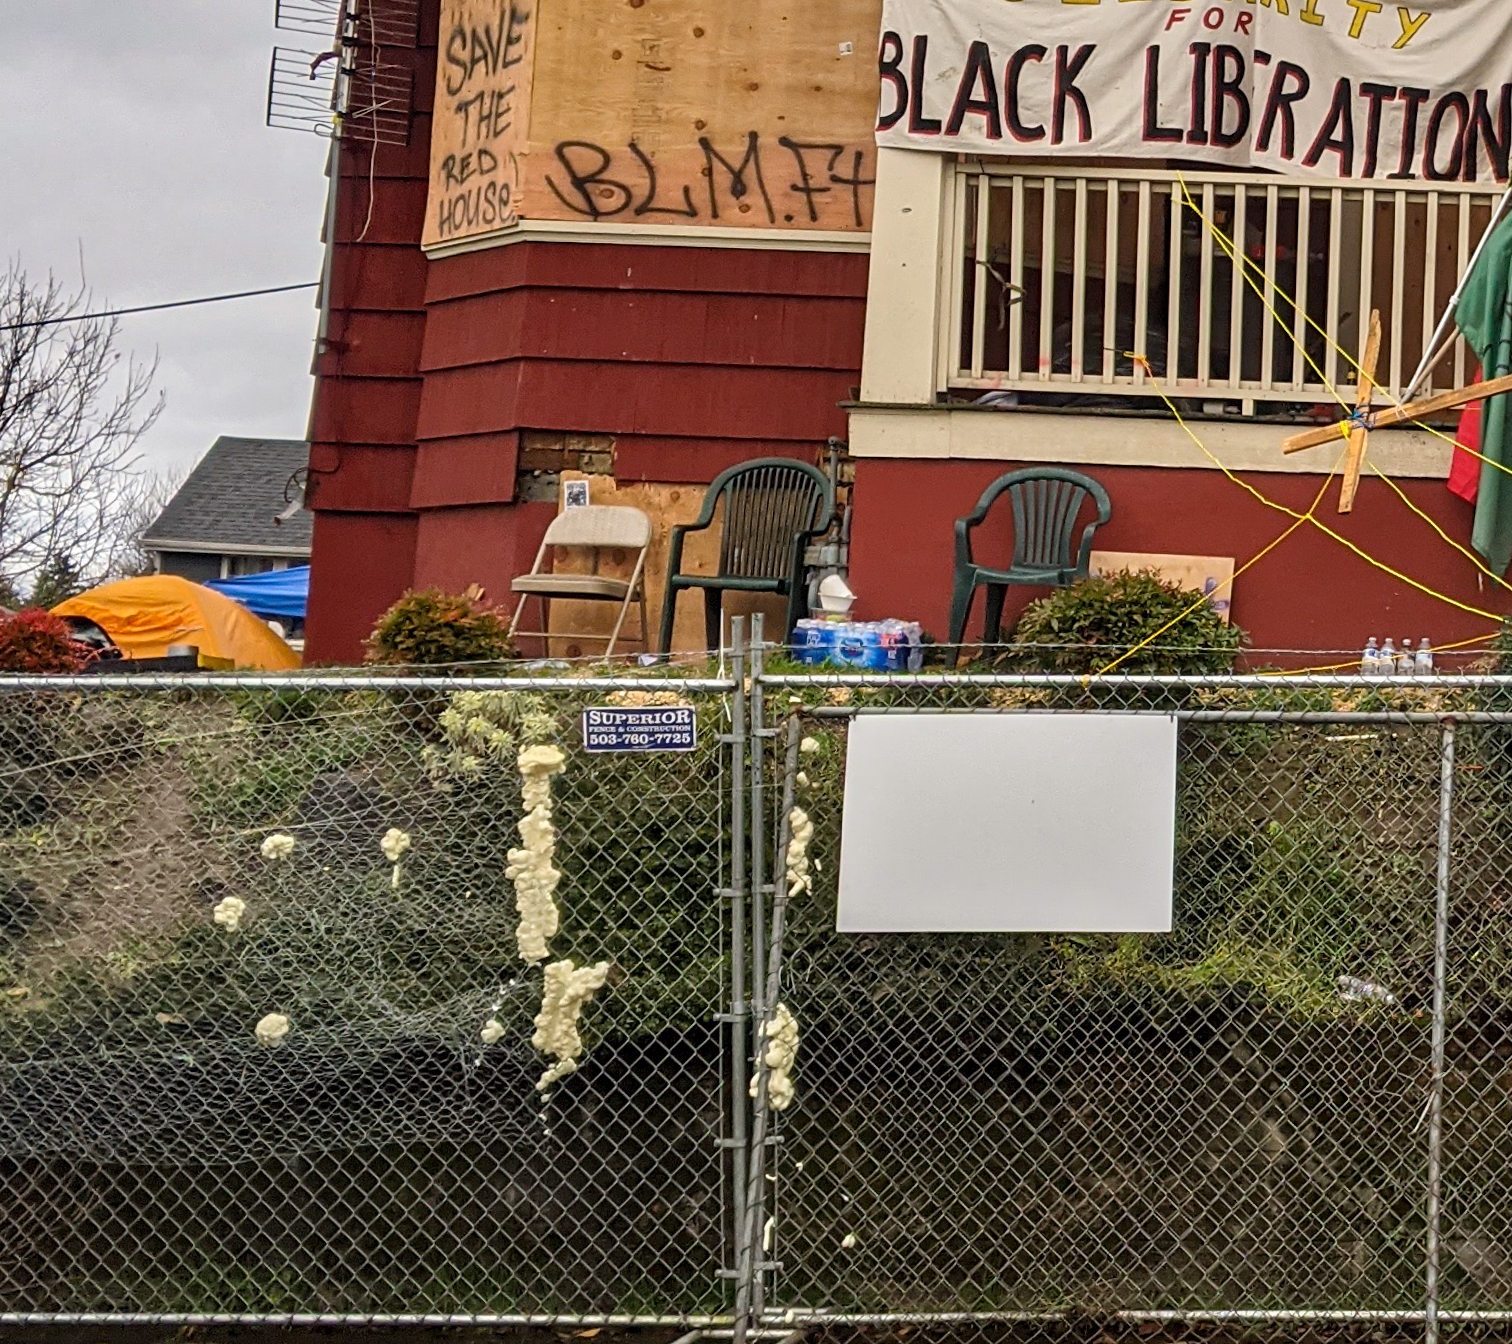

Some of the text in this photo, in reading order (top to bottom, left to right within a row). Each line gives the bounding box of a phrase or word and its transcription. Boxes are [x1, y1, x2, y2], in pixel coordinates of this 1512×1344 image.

[1164, 7, 1254, 36] FOR
[446, 6, 530, 96] SAVE
[875, 30, 1098, 145] BLACK
[455, 85, 516, 149] THE
[442, 148, 498, 192] RED
[588, 709, 692, 725] SUPERIOR
[626, 725, 692, 733] CONSTRUCTION
[589, 733, 692, 745] 503-760-7725
